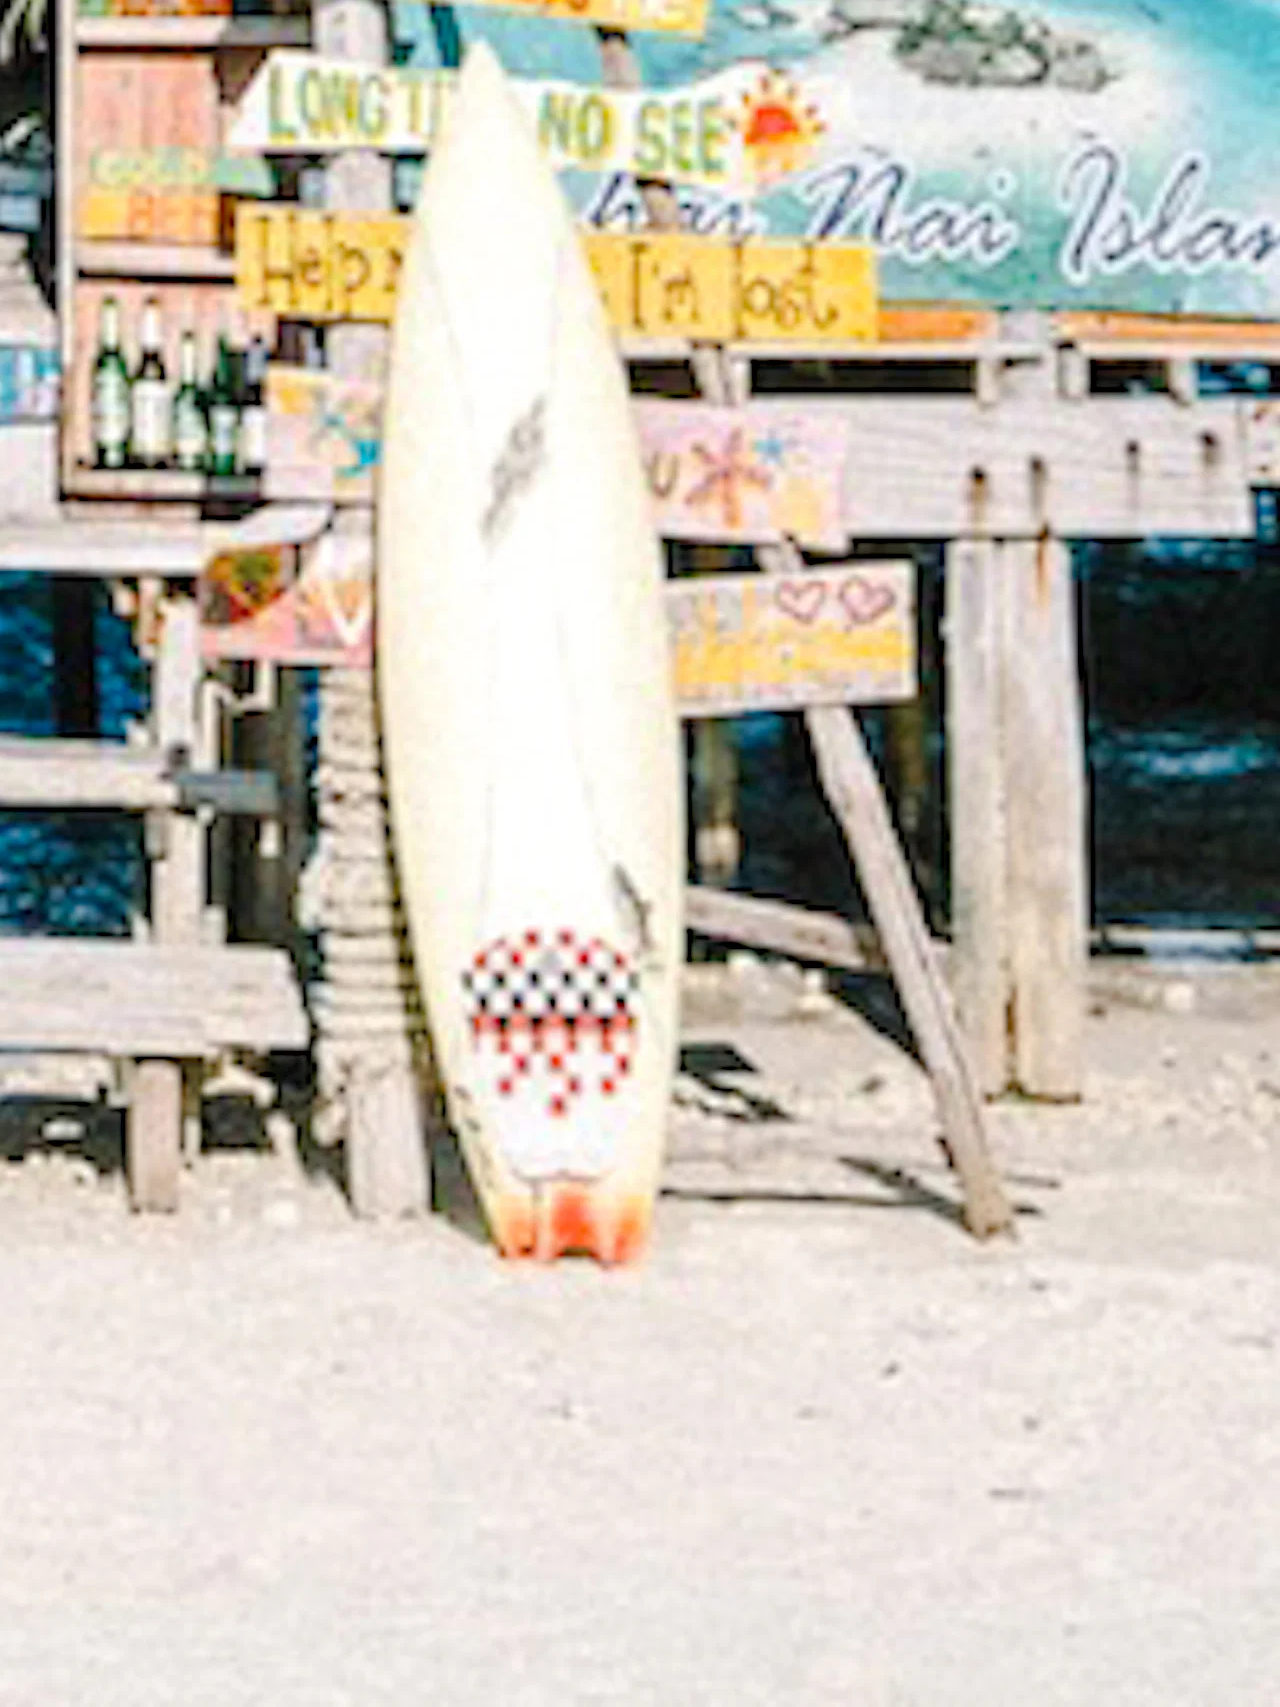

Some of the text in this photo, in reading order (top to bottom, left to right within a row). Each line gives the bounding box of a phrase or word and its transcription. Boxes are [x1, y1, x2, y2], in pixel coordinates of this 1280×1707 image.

[267, 66, 386, 144] LONG
[539, 88, 613, 157] NO
[636, 95, 730, 175] SEE
